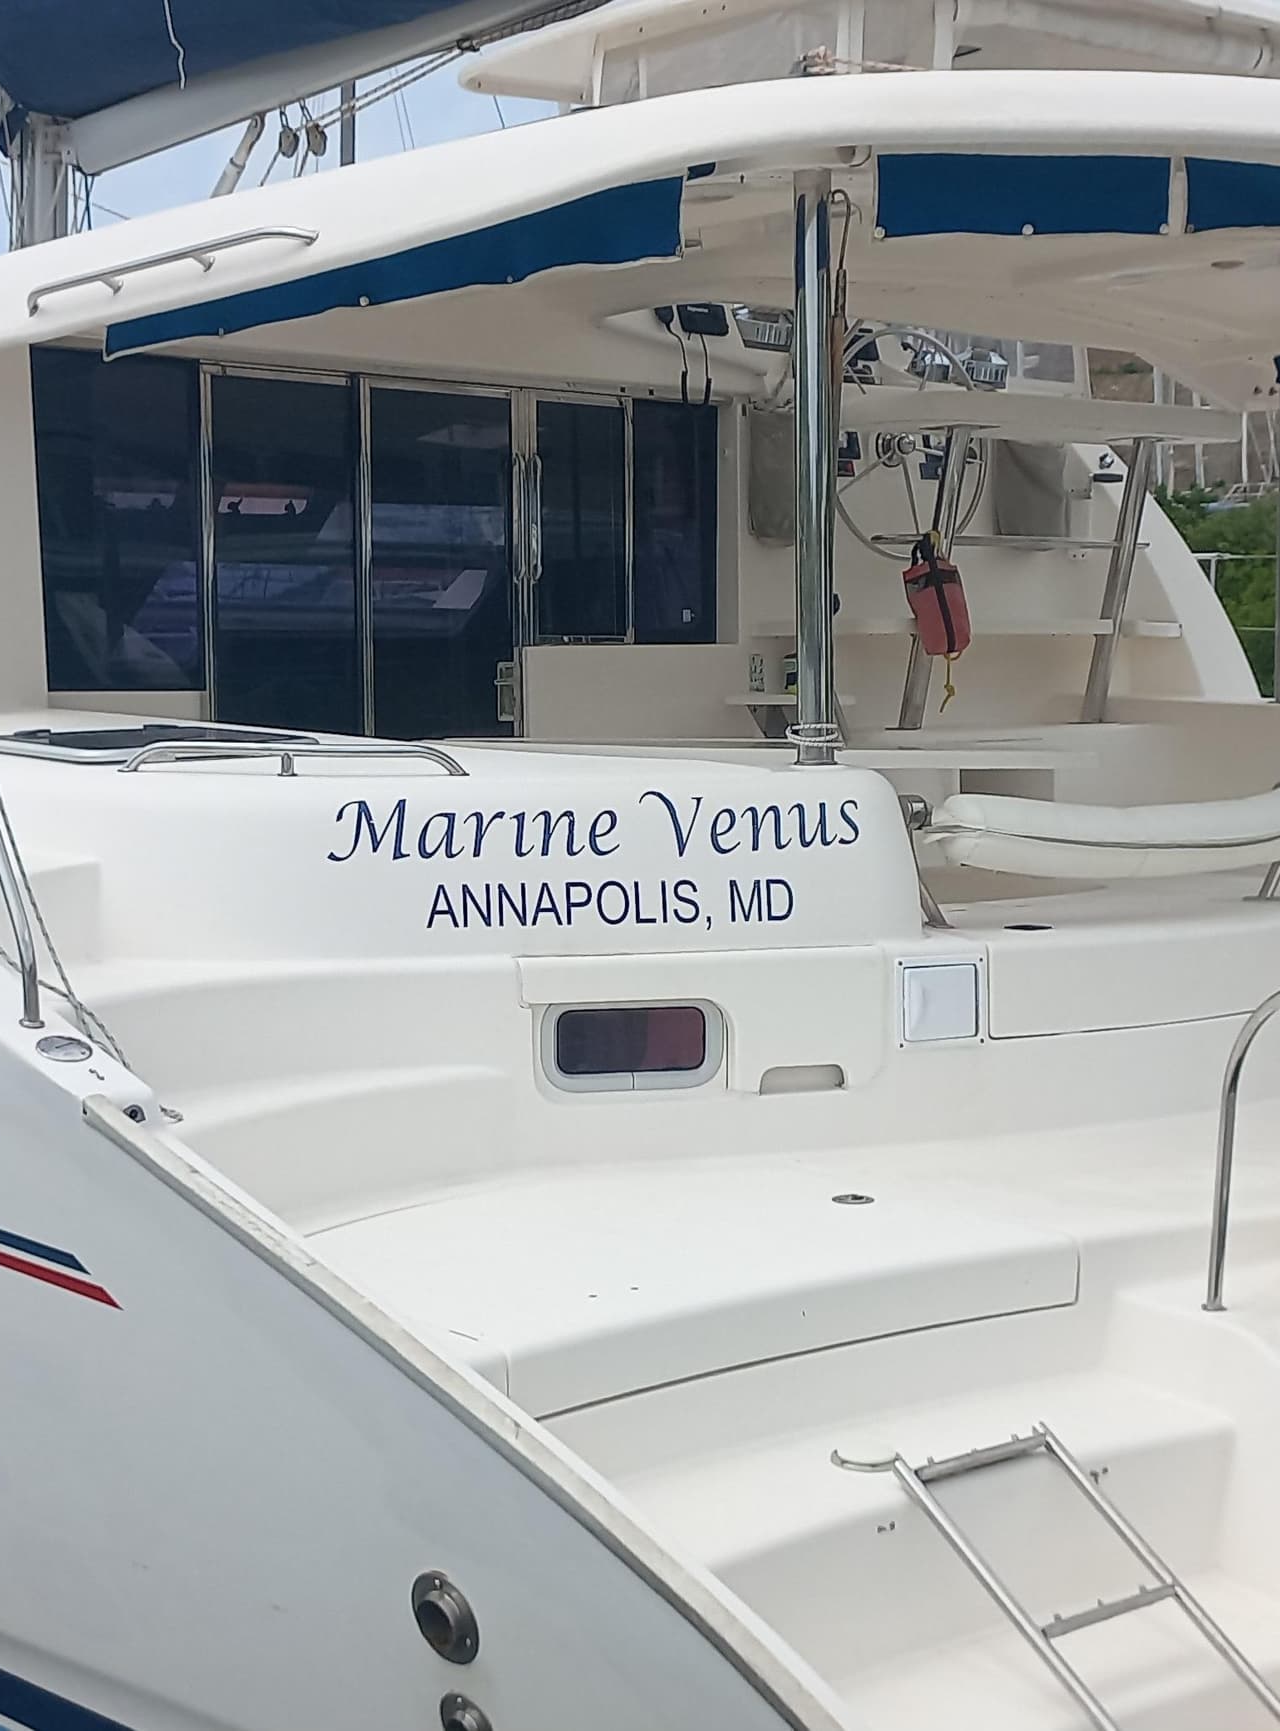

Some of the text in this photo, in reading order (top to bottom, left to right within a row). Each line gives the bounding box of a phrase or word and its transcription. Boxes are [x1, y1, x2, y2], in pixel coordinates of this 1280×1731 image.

[326, 789, 861, 863] Marine Venus
[425, 877, 795, 930] ANNAPOLIS, MD
